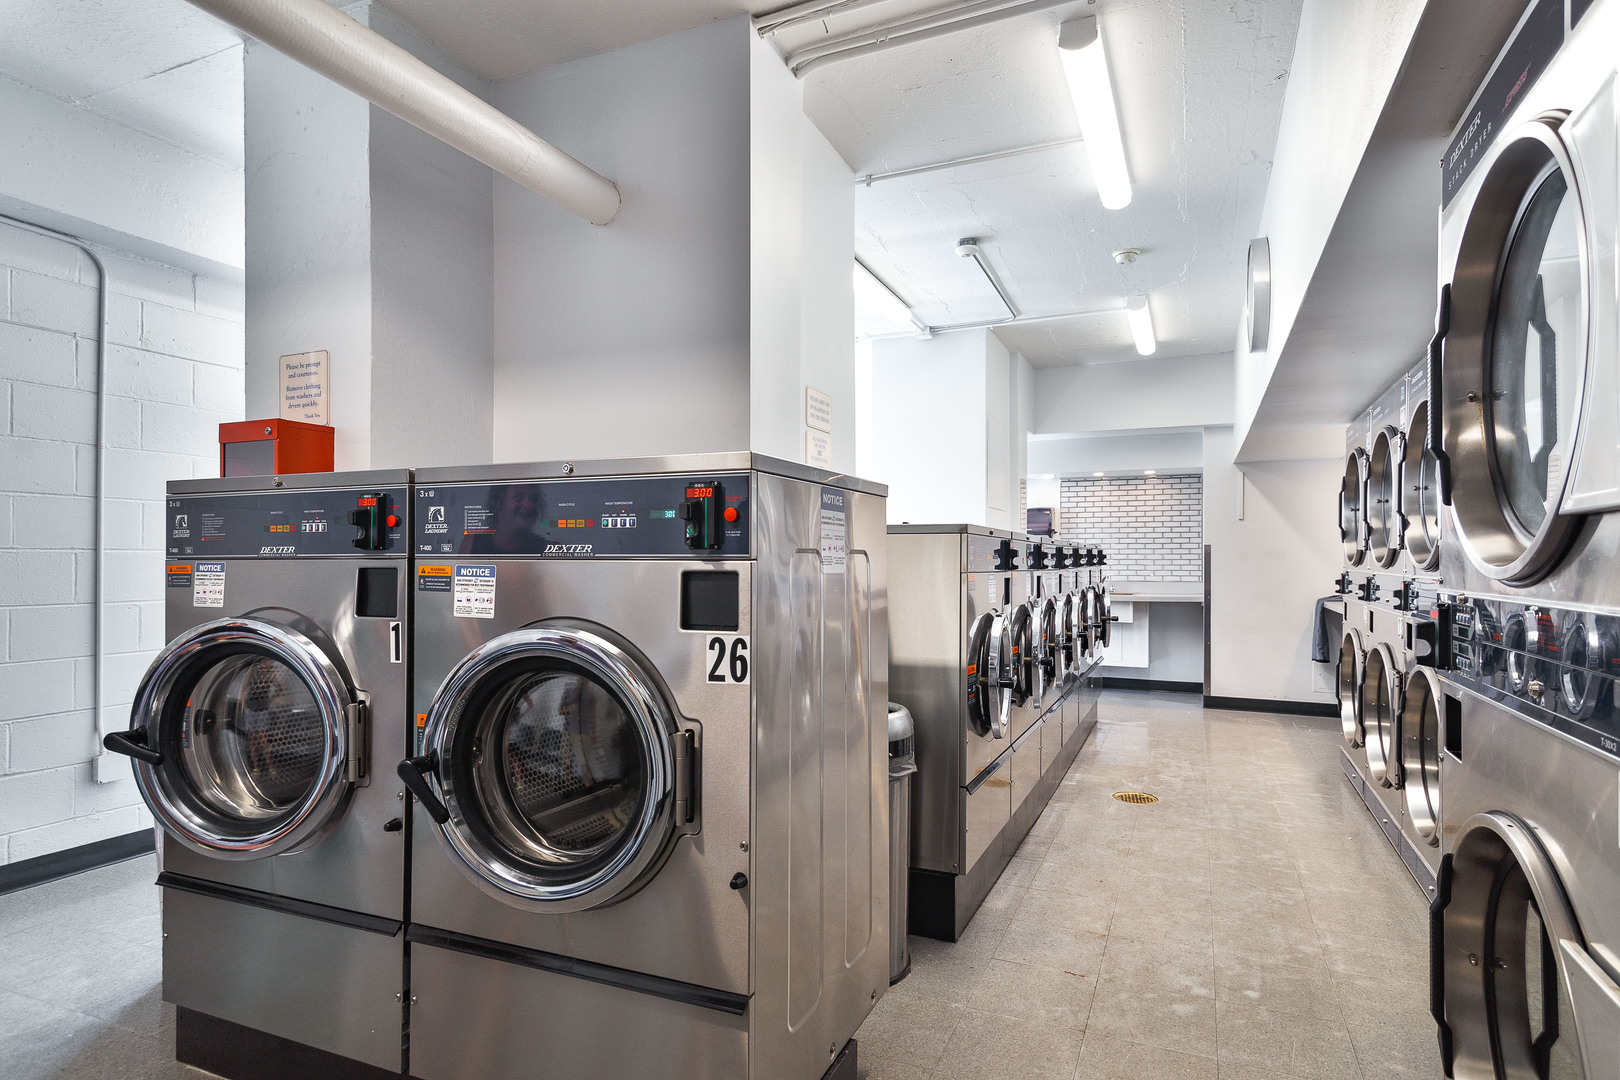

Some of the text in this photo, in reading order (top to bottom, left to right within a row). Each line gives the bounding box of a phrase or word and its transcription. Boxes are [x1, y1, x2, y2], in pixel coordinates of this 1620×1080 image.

[1448, 122, 1492, 190] STACK DRYER
[1449, 111, 1481, 170] DEXTER
[823, 494, 843, 506] NOTICE
[544, 544, 592, 552] DEXTER
[392, 623, 400, 661] 1
[708, 636, 748, 683] 26
